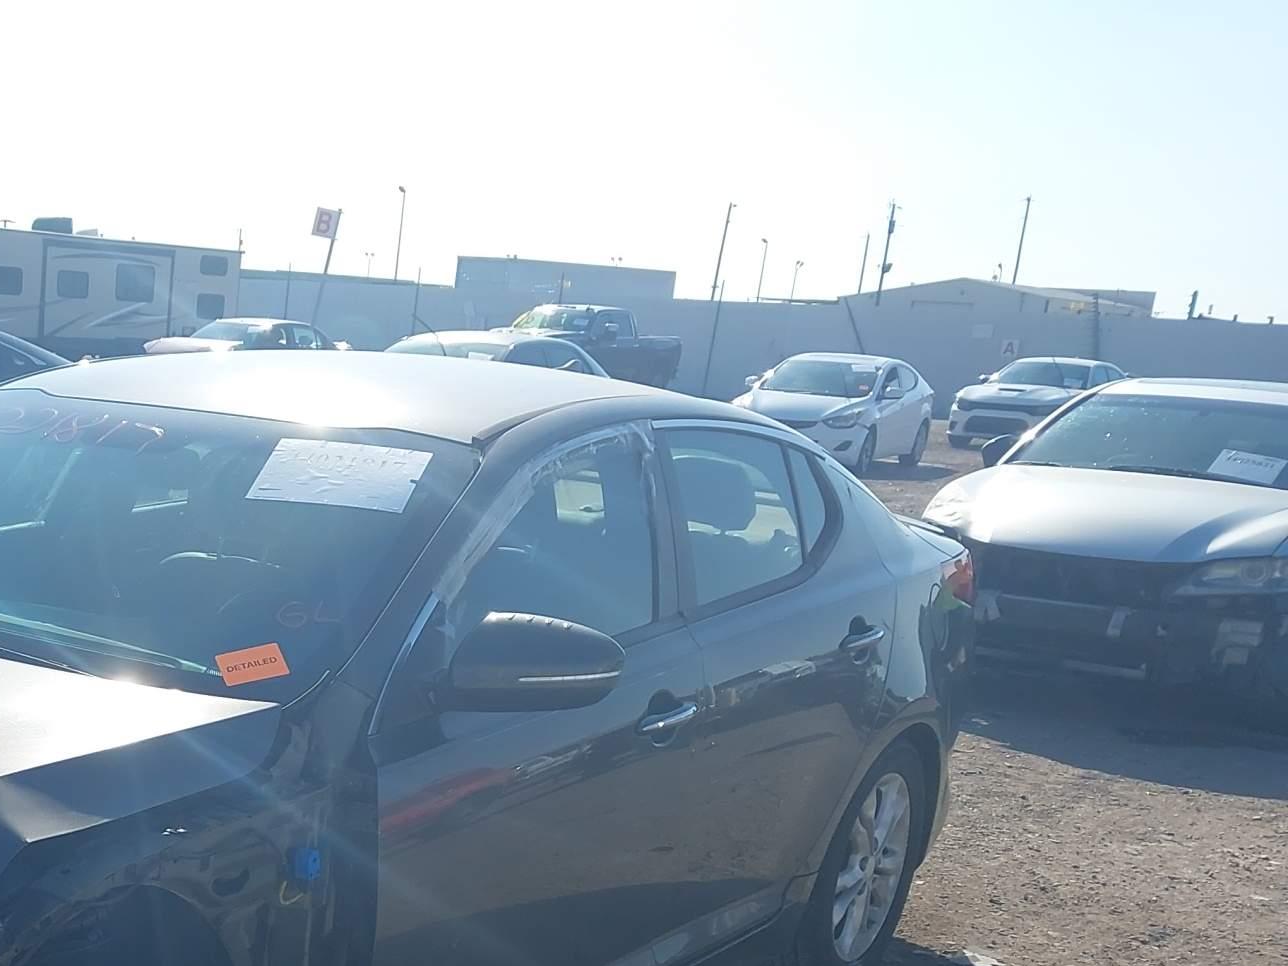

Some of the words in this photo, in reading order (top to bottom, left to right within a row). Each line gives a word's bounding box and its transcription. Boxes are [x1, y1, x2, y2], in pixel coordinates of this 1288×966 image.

[316, 211, 332, 234] B
[1003, 341, 1015, 354] A
[226, 656, 278, 673] DETAILED
